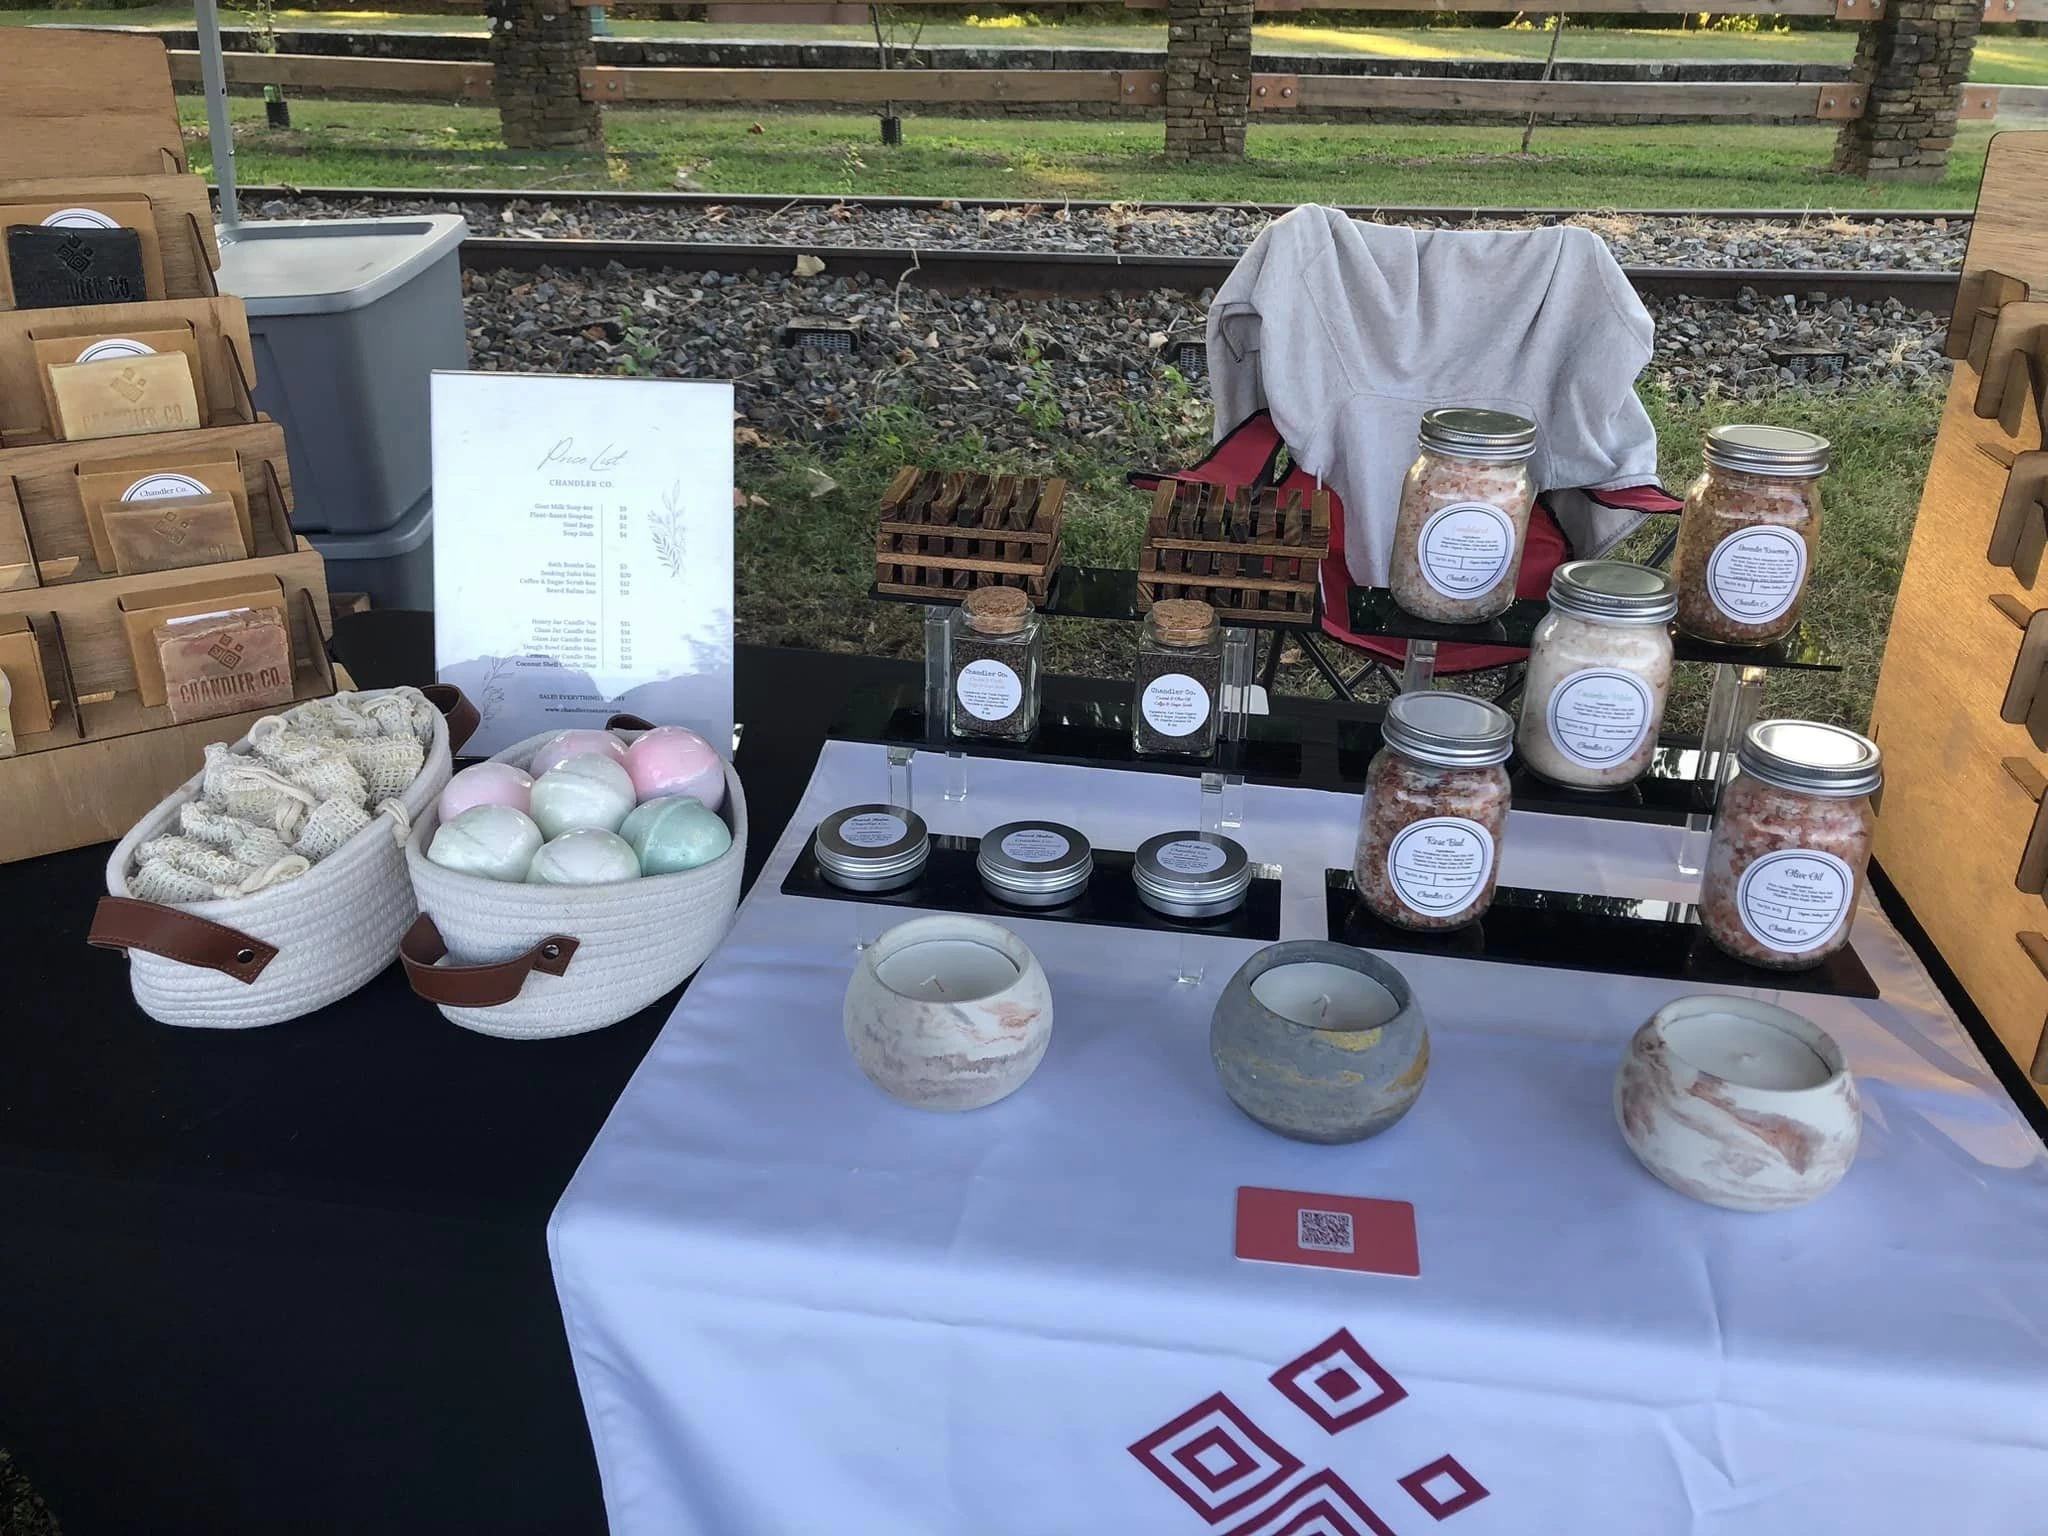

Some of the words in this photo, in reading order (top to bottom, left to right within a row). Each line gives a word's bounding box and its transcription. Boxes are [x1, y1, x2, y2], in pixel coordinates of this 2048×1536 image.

[537, 436, 587, 471] Price
[590, 442, 628, 471] List
[549, 480, 597, 488] CHANDLER
[140, 488, 174, 497] Chandler
[965, 669, 996, 677] Chandler
[179, 673, 256, 703] CHANDLER
[260, 667, 286, 688] CO.
[1151, 687, 1184, 695] Chandler
[1185, 688, 1196, 696] Co.
[1425, 836, 1446, 847] Rose
[1446, 838, 1465, 847] Bud
[1785, 868, 1808, 880] Olive
[1809, 872, 1825, 881] Oil
[1769, 924, 1796, 935] Chandler
